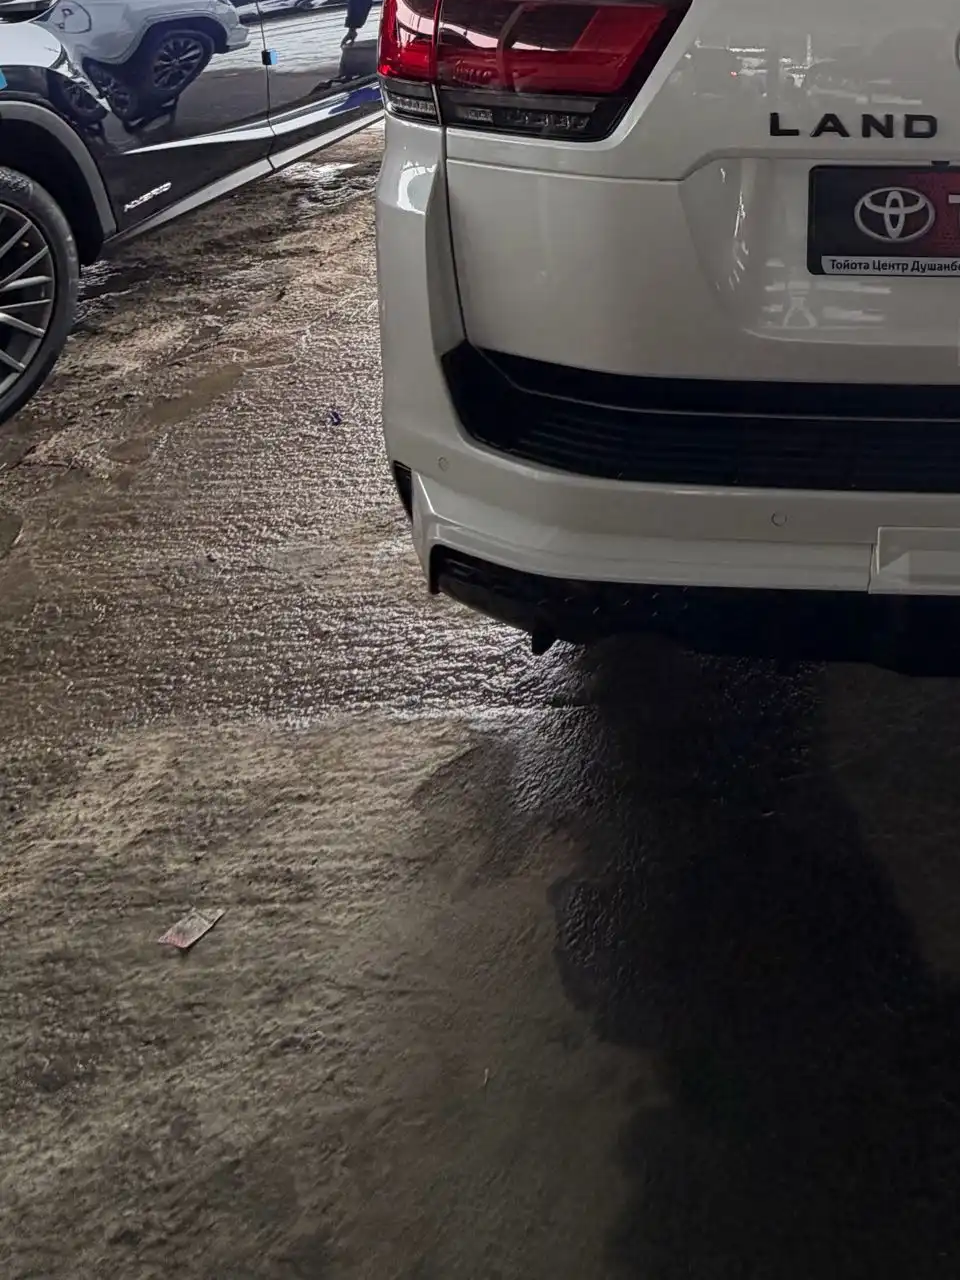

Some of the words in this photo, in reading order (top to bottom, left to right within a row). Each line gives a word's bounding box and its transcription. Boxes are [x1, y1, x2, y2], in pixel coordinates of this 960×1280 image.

[768, 112, 939, 139] LAND
[829, 259, 870, 270] Тойота
[872, 260, 909, 273] Центр
